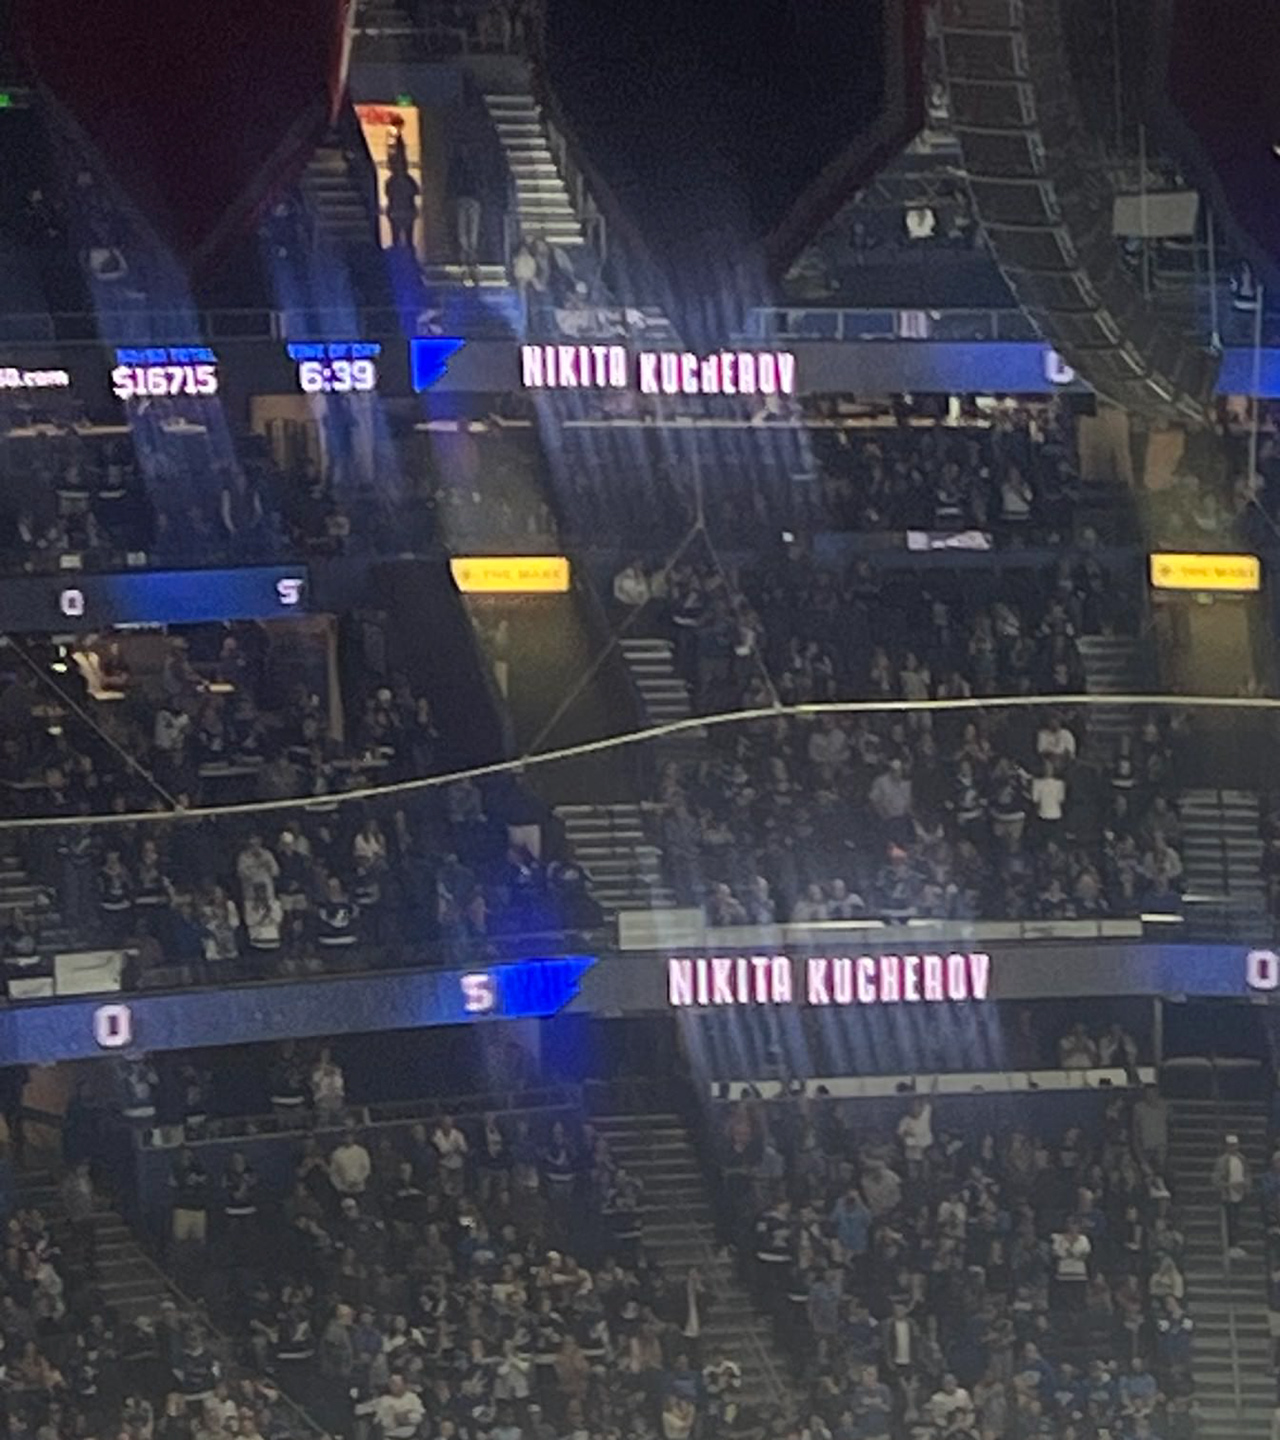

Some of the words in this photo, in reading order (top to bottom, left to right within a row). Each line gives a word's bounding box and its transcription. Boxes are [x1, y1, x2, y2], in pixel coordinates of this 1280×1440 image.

[300, 361, 376, 393] 6:39
[522, 345, 627, 387] NIKITA
[669, 957, 792, 1005] NIKITA
[808, 954, 990, 1004] KUCHEROV
[1246, 950, 1280, 991] 0
